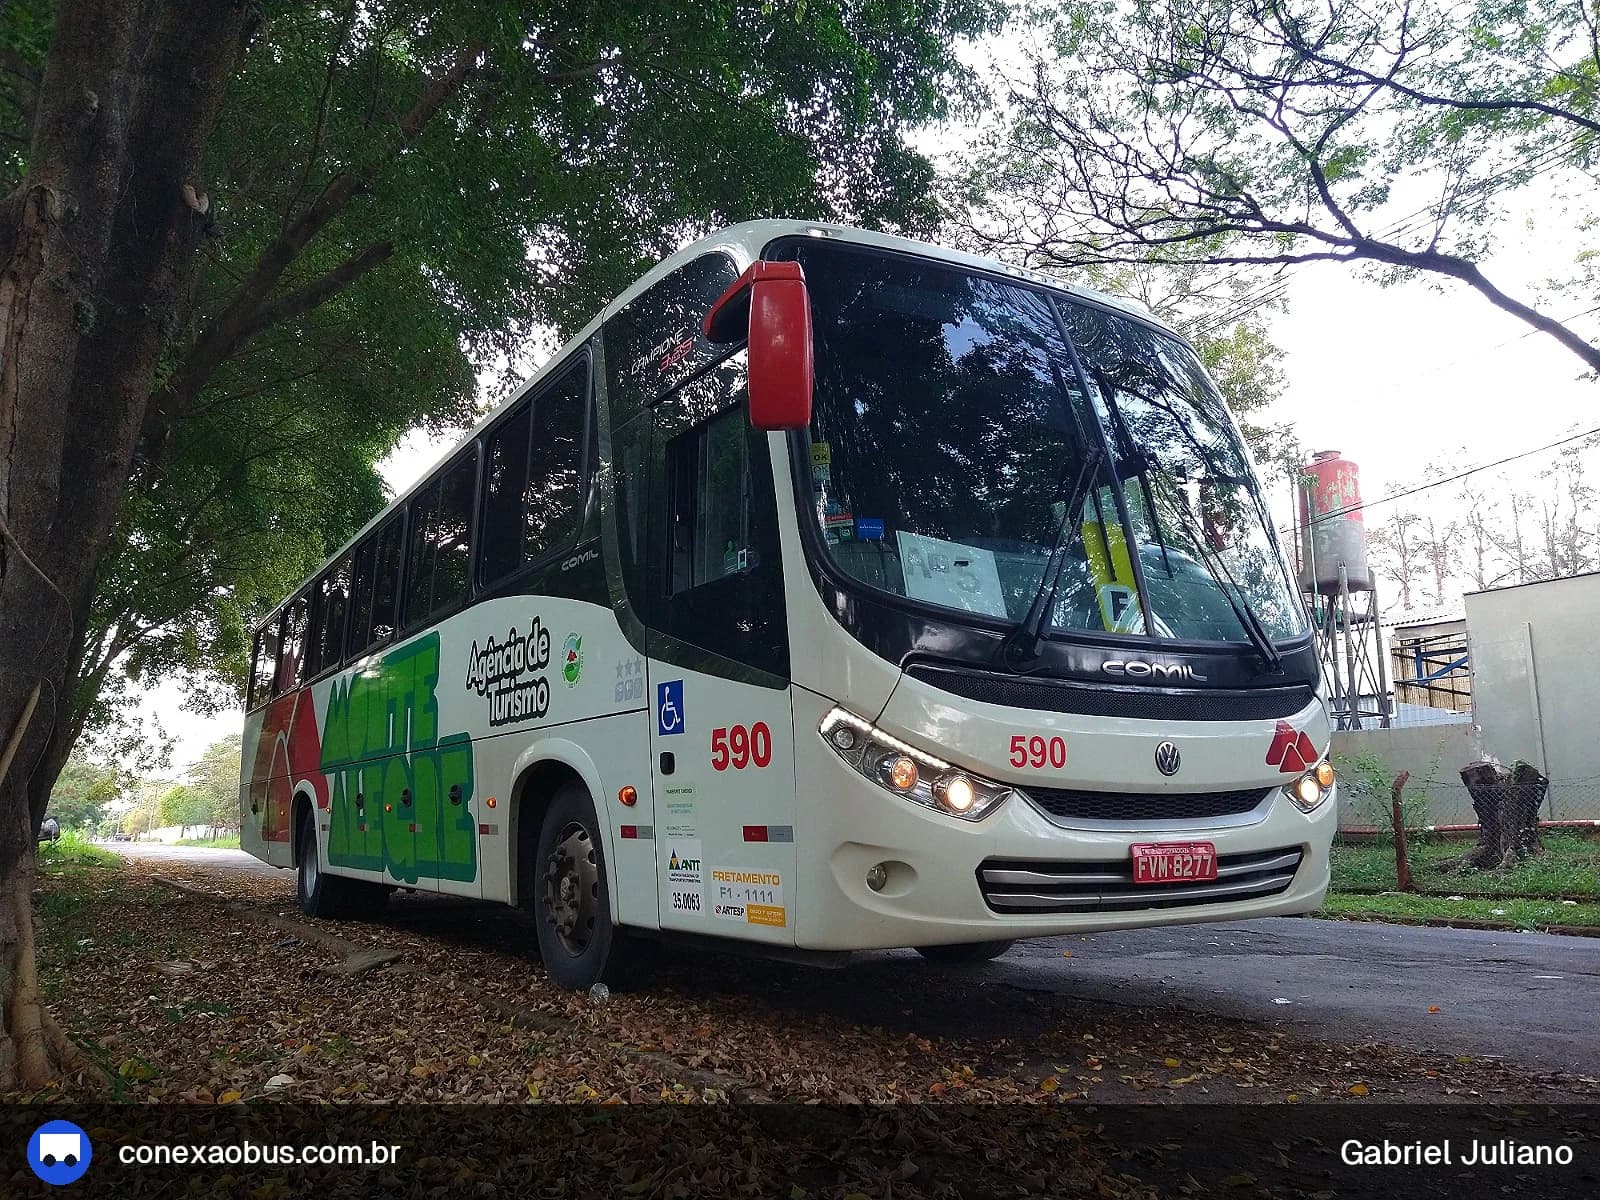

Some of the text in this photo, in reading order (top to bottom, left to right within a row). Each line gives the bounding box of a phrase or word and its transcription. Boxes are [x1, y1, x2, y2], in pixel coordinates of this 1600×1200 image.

[561, 549, 599, 571] COMIL
[466, 626, 526, 696] Agência
[526, 615, 551, 672] de
[1101, 660, 1207, 682] COMIL
[486, 676, 551, 727] Turismo
[711, 722, 772, 771] 590
[1009, 735, 1066, 769] 590
[681, 859, 701, 871] ANTT
[712, 870, 780, 886] FRETAMENTO
[745, 889, 773, 903] 1111
[722, 905, 745, 917] ARTESP
